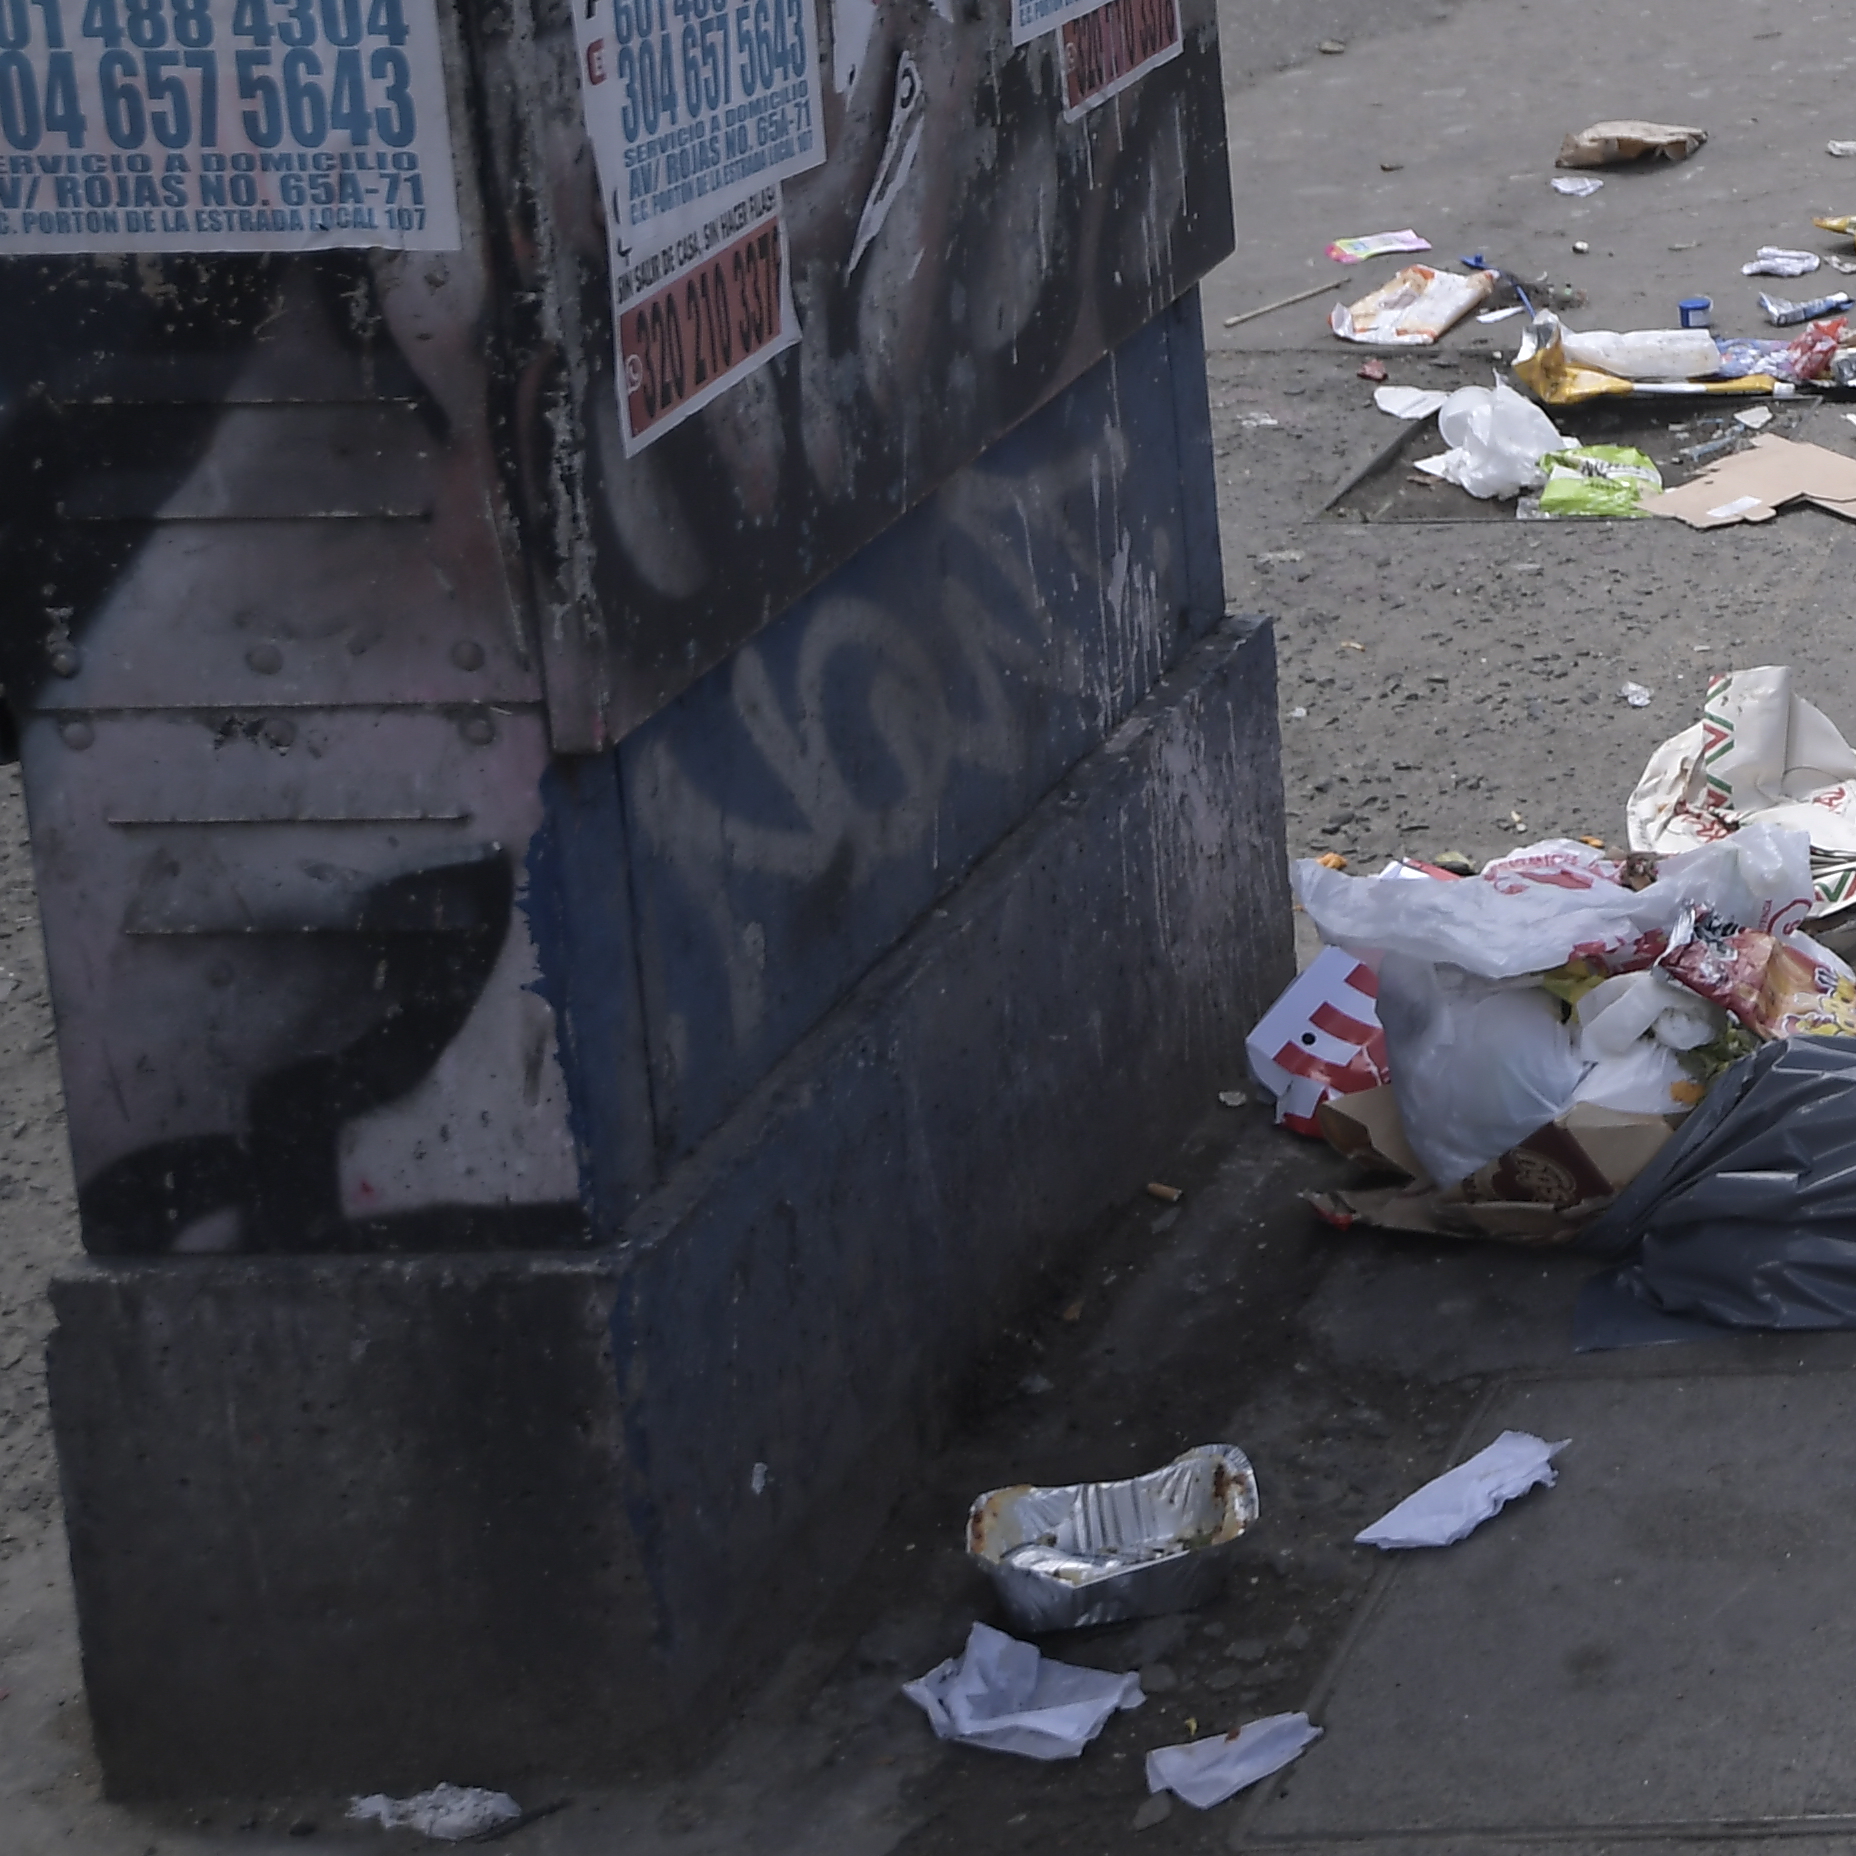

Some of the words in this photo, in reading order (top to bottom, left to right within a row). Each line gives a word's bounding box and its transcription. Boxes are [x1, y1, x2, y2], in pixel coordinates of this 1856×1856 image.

[100, 48, 219, 149] 657
[235, 47, 417, 148] 5643
[619, 33, 678, 143] 304
[683, 13, 731, 118] 657
[57, 174, 188, 208] ROJAS
[200, 173, 270, 208] NO.
[280, 173, 426, 208] 65A-71
[165, 151, 191, 172] A
[202, 151, 419, 172] DOMICILIO
[24, 210, 118, 234] PORTON
[126, 210, 156, 234] DE
[162, 210, 191, 233] LA
[195, 209, 304, 233] ESTRADA
[309, 207, 379, 231] LOCAL
[384, 207, 427, 232] 107
[636, 291, 684, 419] 320
[688, 261, 733, 387] 210
